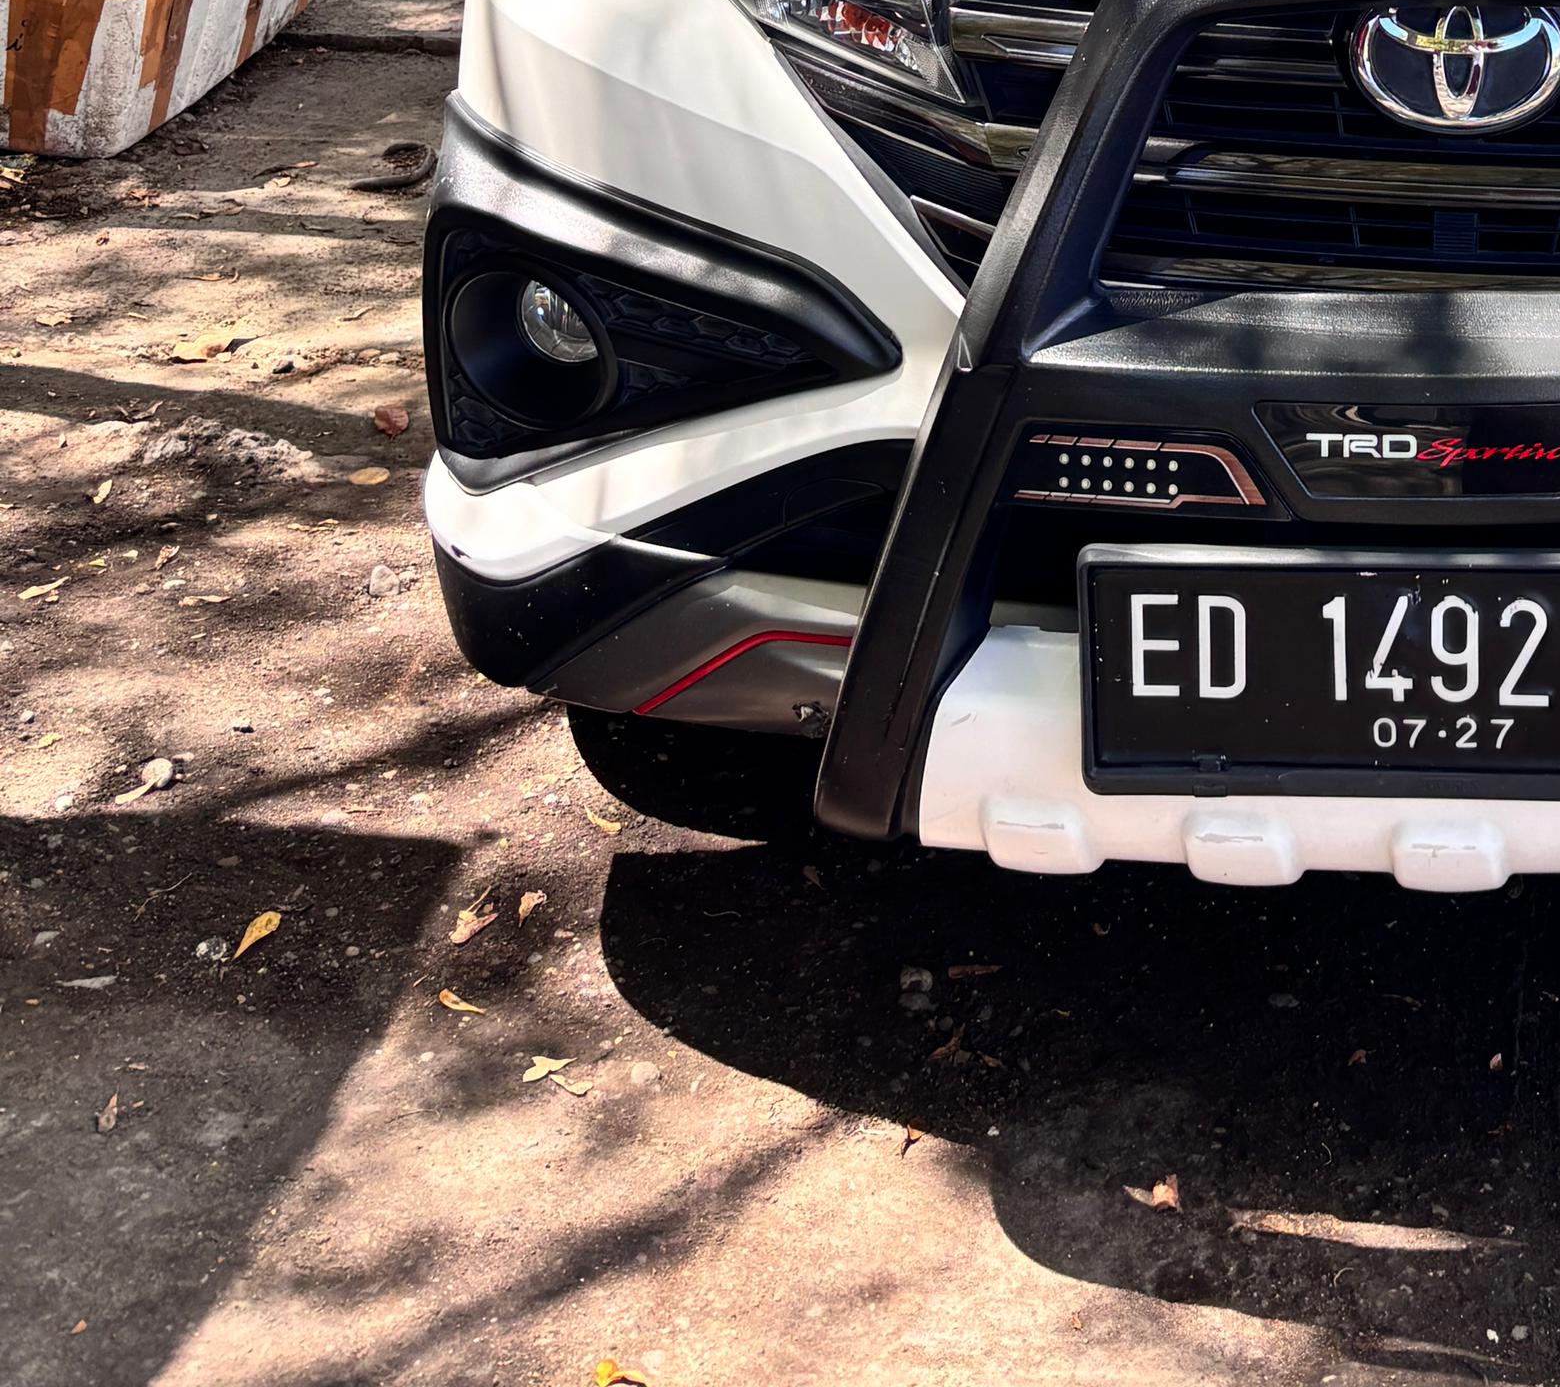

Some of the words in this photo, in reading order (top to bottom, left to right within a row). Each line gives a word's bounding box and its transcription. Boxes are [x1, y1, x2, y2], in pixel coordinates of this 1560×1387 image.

[1306, 433, 1417, 459] TRD
[1130, 594, 1248, 699] ED
[1322, 595, 1550, 708] 1492
